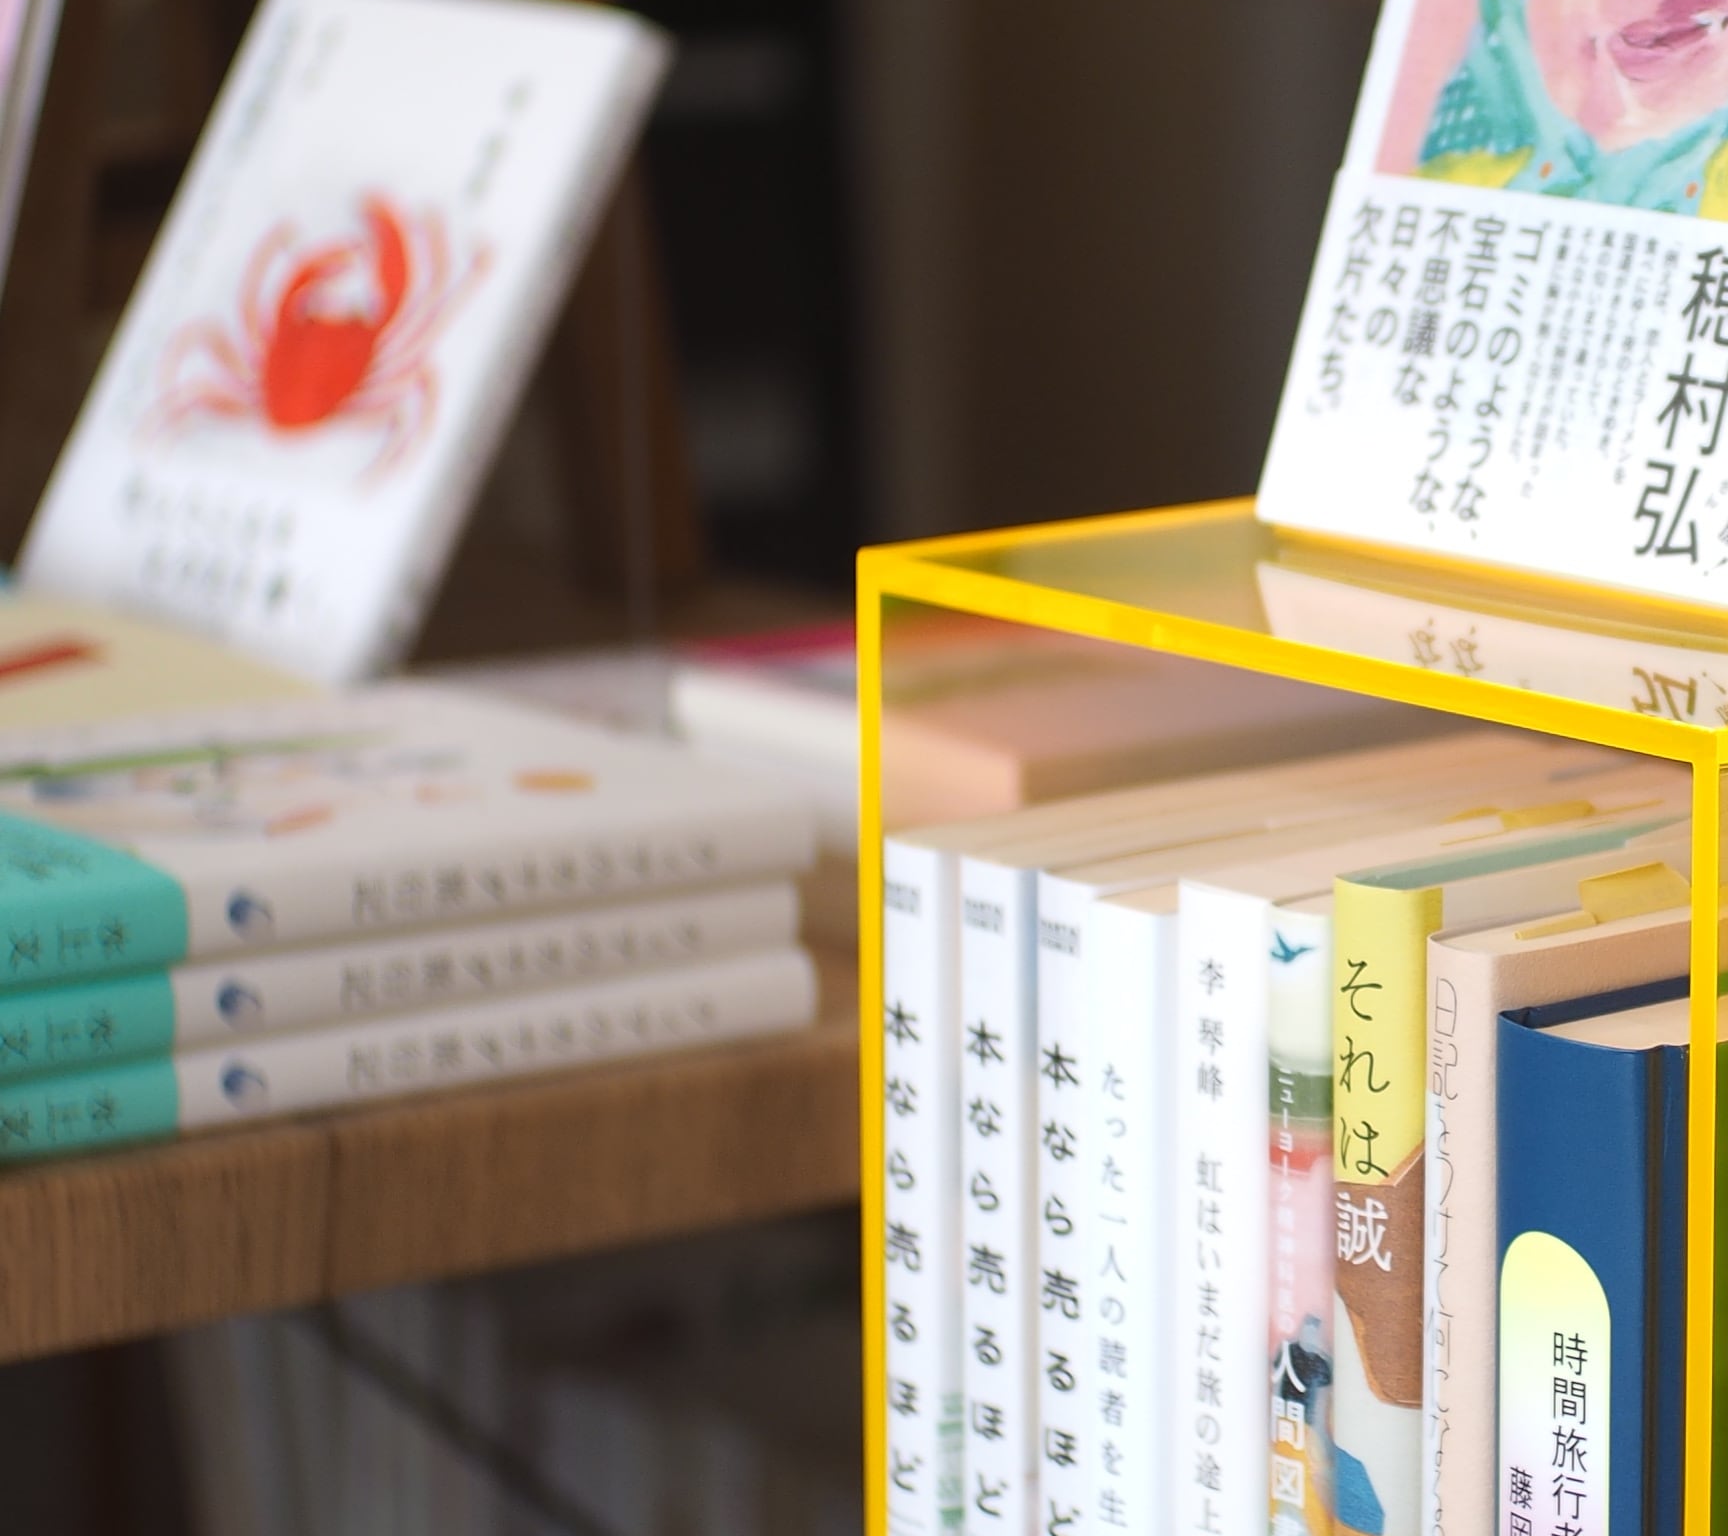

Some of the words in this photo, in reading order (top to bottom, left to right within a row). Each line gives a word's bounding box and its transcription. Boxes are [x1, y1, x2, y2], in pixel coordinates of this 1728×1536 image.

[1364, 203, 1422, 348] 日々の
[1394, 207, 1466, 408] 不思議な
[1408, 213, 1508, 532] 宝石のような、
[1451, 221, 1553, 540] ゴミのような、
[884, 999, 923, 1493] 本なら売るほど
[966, 1018, 1007, 1518] 本なら売るほど
[1336, 956, 1392, 1271] それは誠
[1193, 1153, 1226, 1536] 虹はいまだ旅の途上
